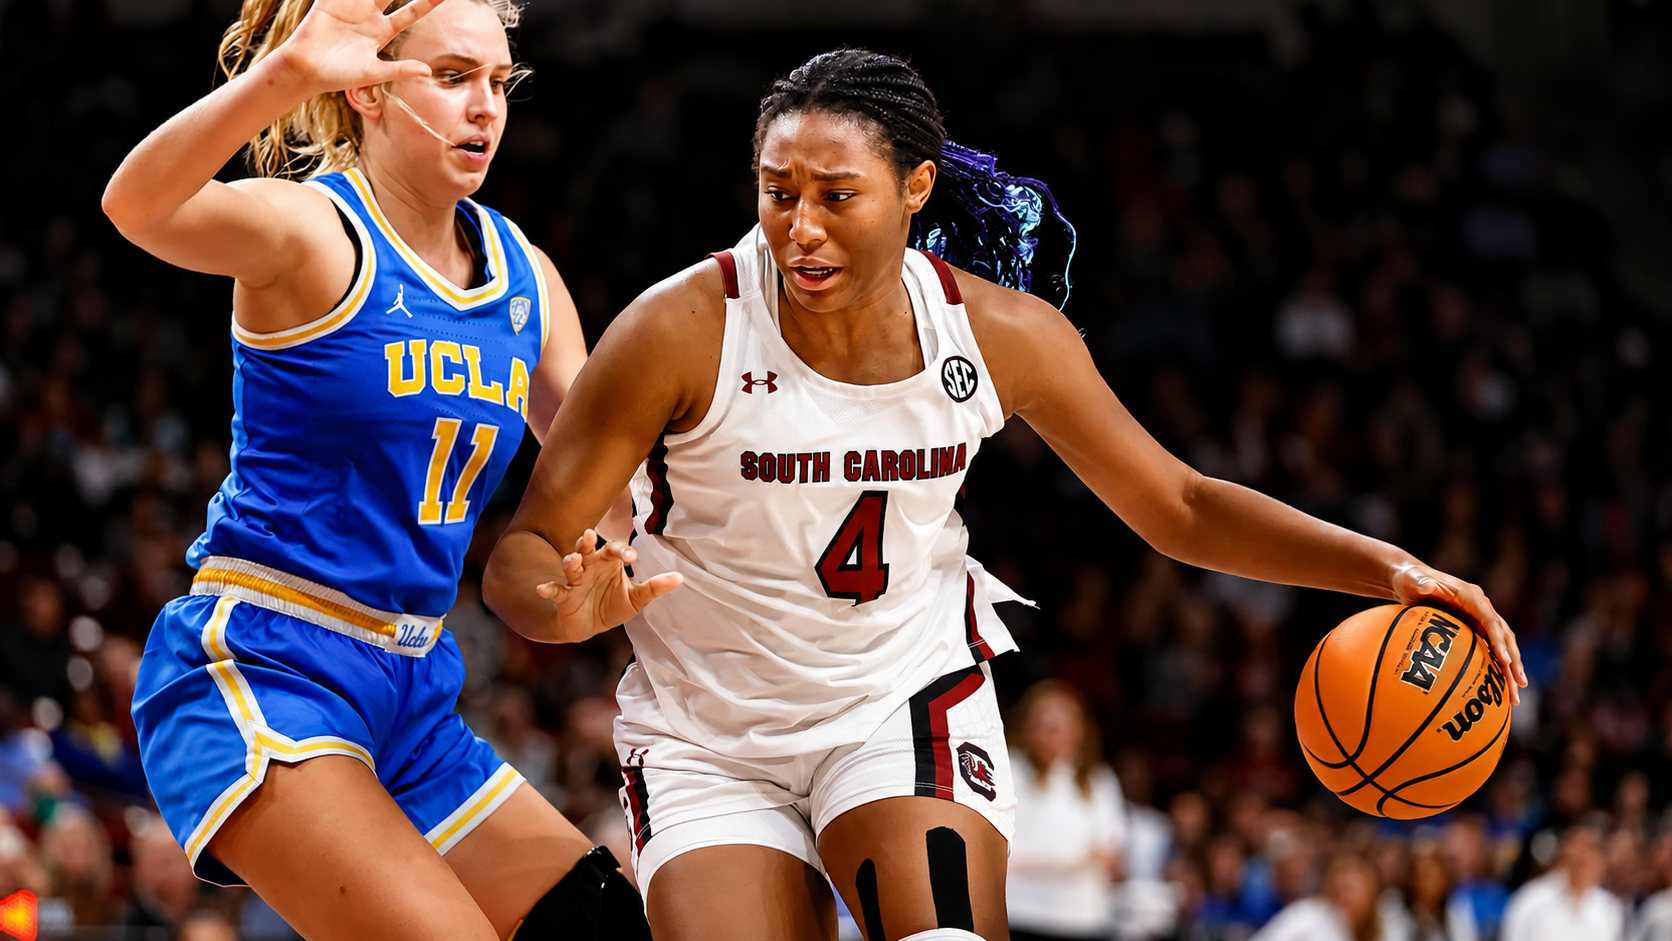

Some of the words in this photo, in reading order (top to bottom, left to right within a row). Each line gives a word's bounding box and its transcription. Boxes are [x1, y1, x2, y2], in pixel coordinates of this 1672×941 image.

[384, 339, 530, 423] UCLA
[943, 359, 976, 399] SEC
[417, 416, 500, 525] 11
[740, 450, 831, 484] SOUTH
[843, 442, 967, 482] CAROLINA
[814, 490, 890, 607] 4
[1400, 613, 1460, 690] NCAA
